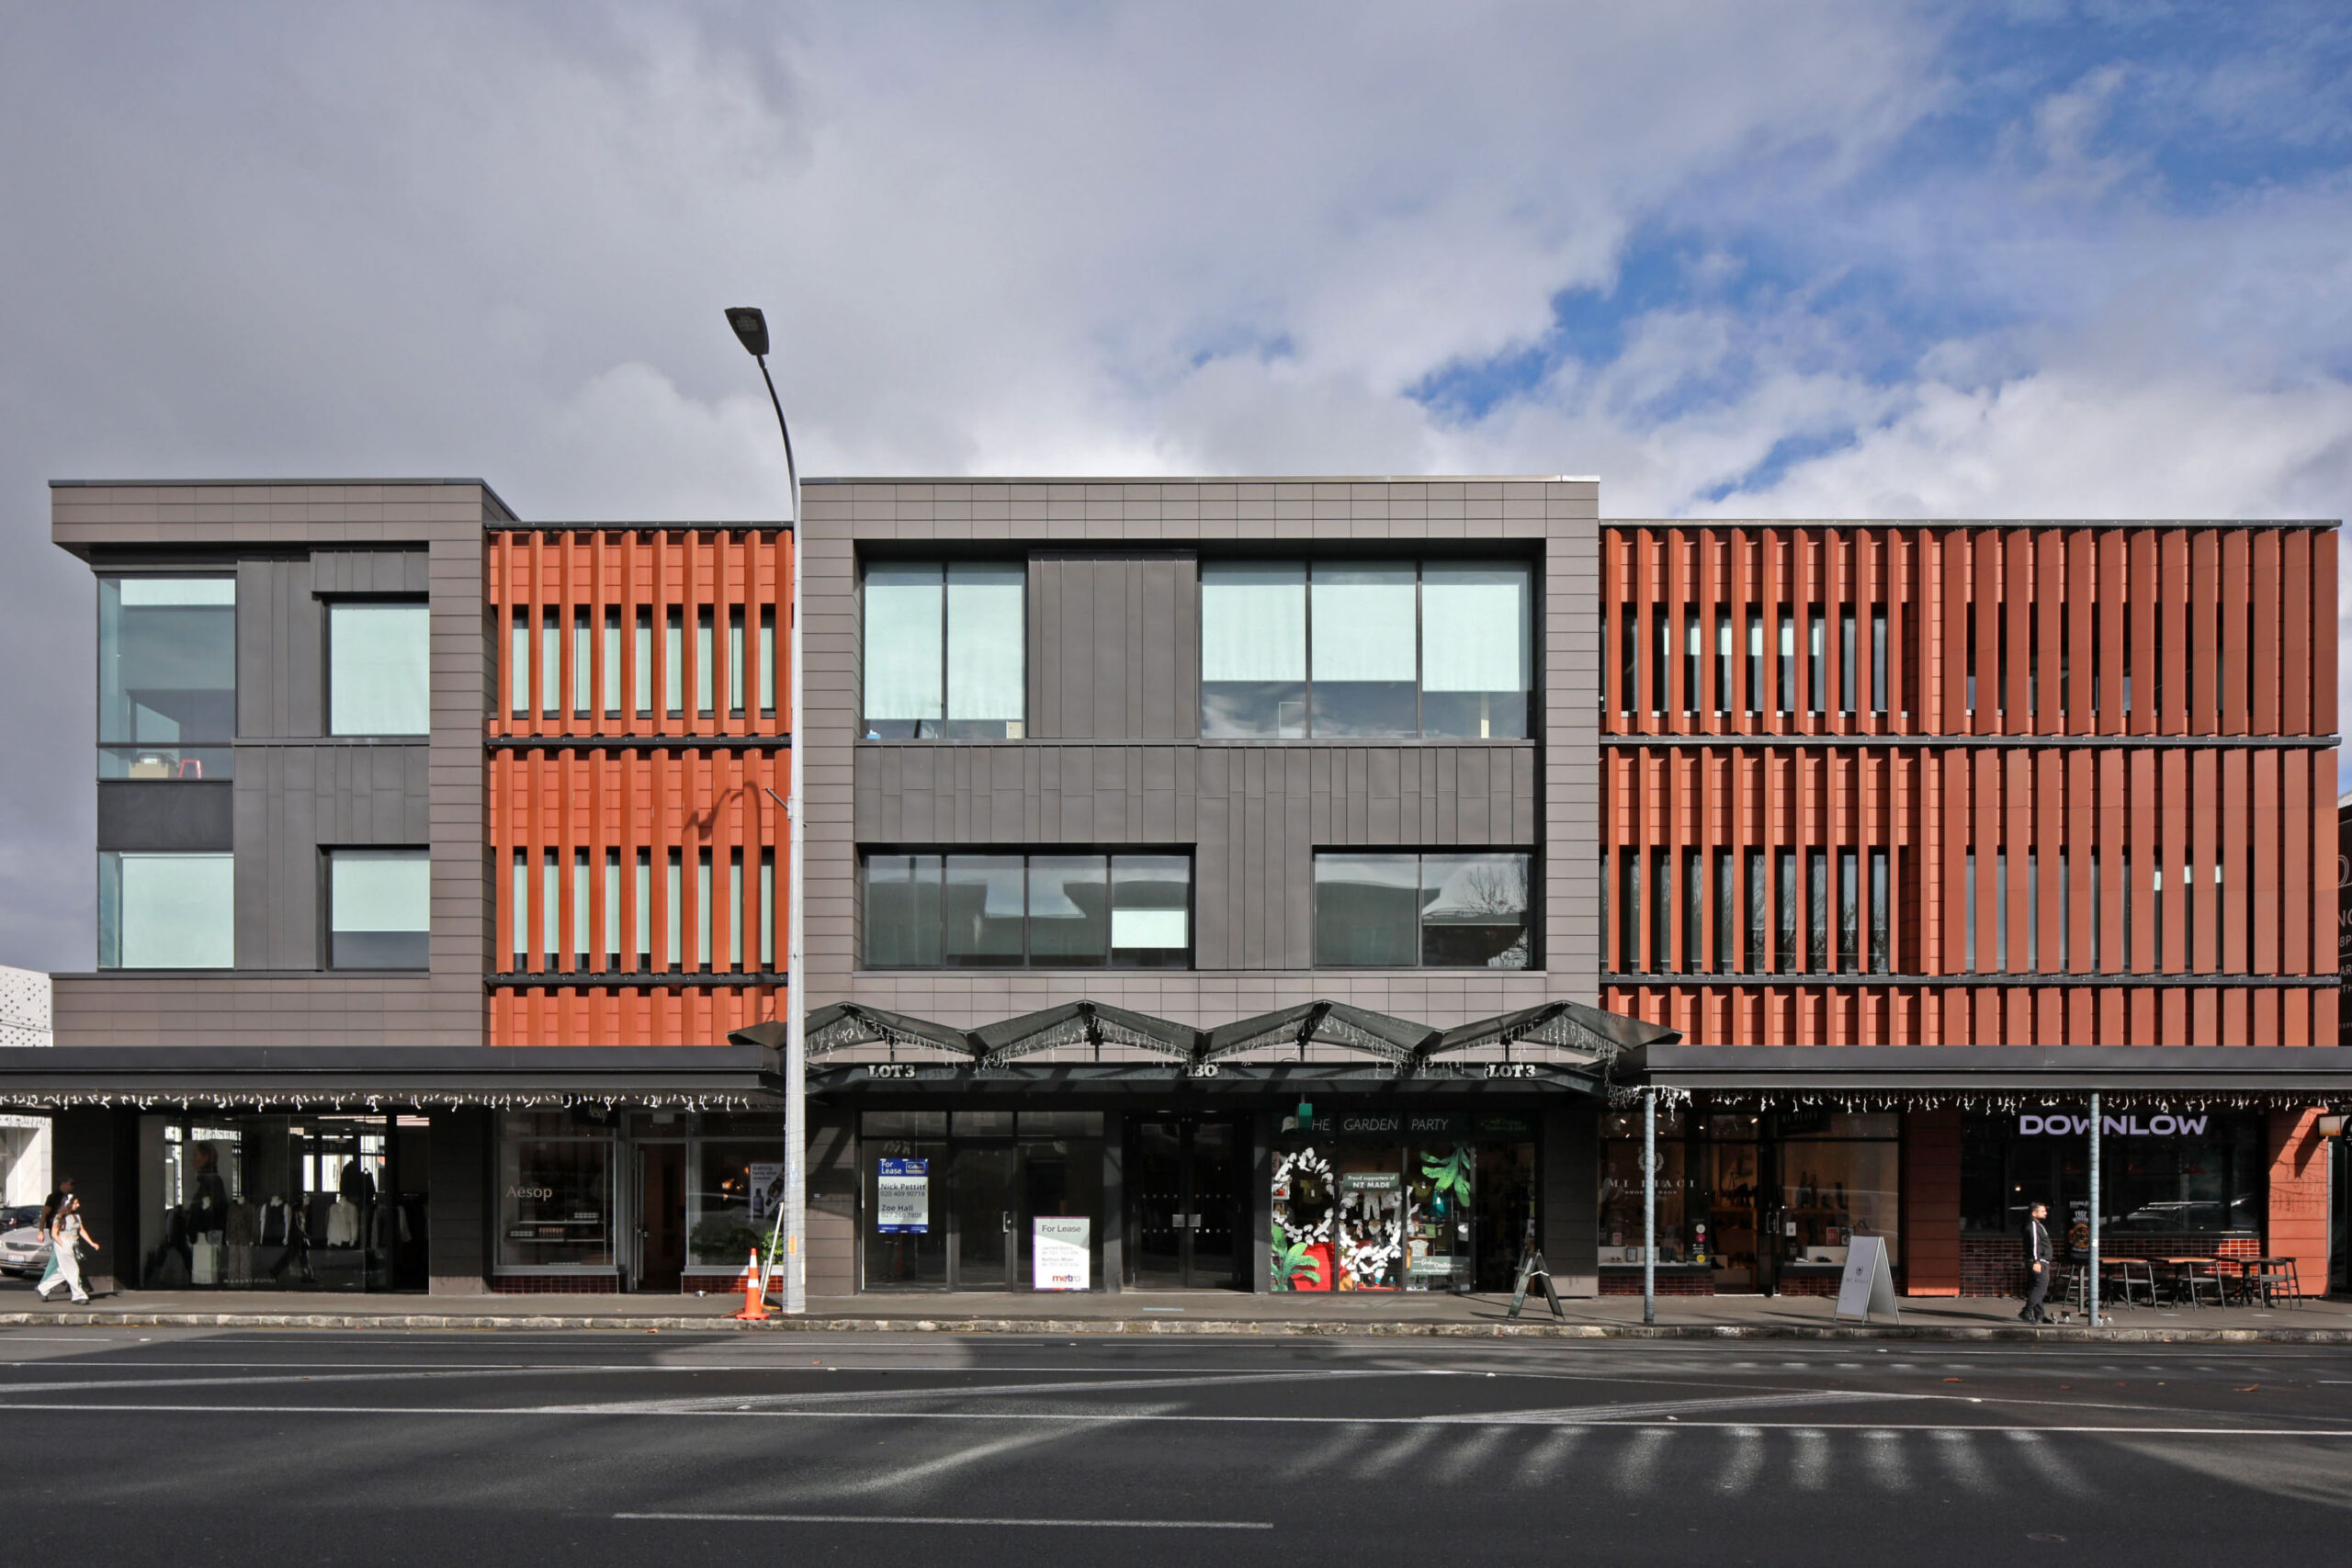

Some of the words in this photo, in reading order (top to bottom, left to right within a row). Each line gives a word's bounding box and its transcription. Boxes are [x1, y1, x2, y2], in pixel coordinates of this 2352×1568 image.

[867, 1065, 903, 1077] LOT
[905, 1065, 915, 1077] 3
[1488, 1065, 1524, 1077] LOT
[1525, 1065, 1536, 1077] 3
[1311, 1118, 1330, 1131] HE
[1343, 1118, 1398, 1131] GARDEN
[1410, 1118, 1449, 1131] PARTY
[2019, 1115, 2208, 1135] DOWNLOW
[880, 1182, 899, 1190] Nick
[506, 1185, 553, 1202] Aesop
[1042, 1224, 1056, 1233] For
[1057, 1224, 1081, 1233] Lease
[1052, 1273, 1081, 1282] metro
